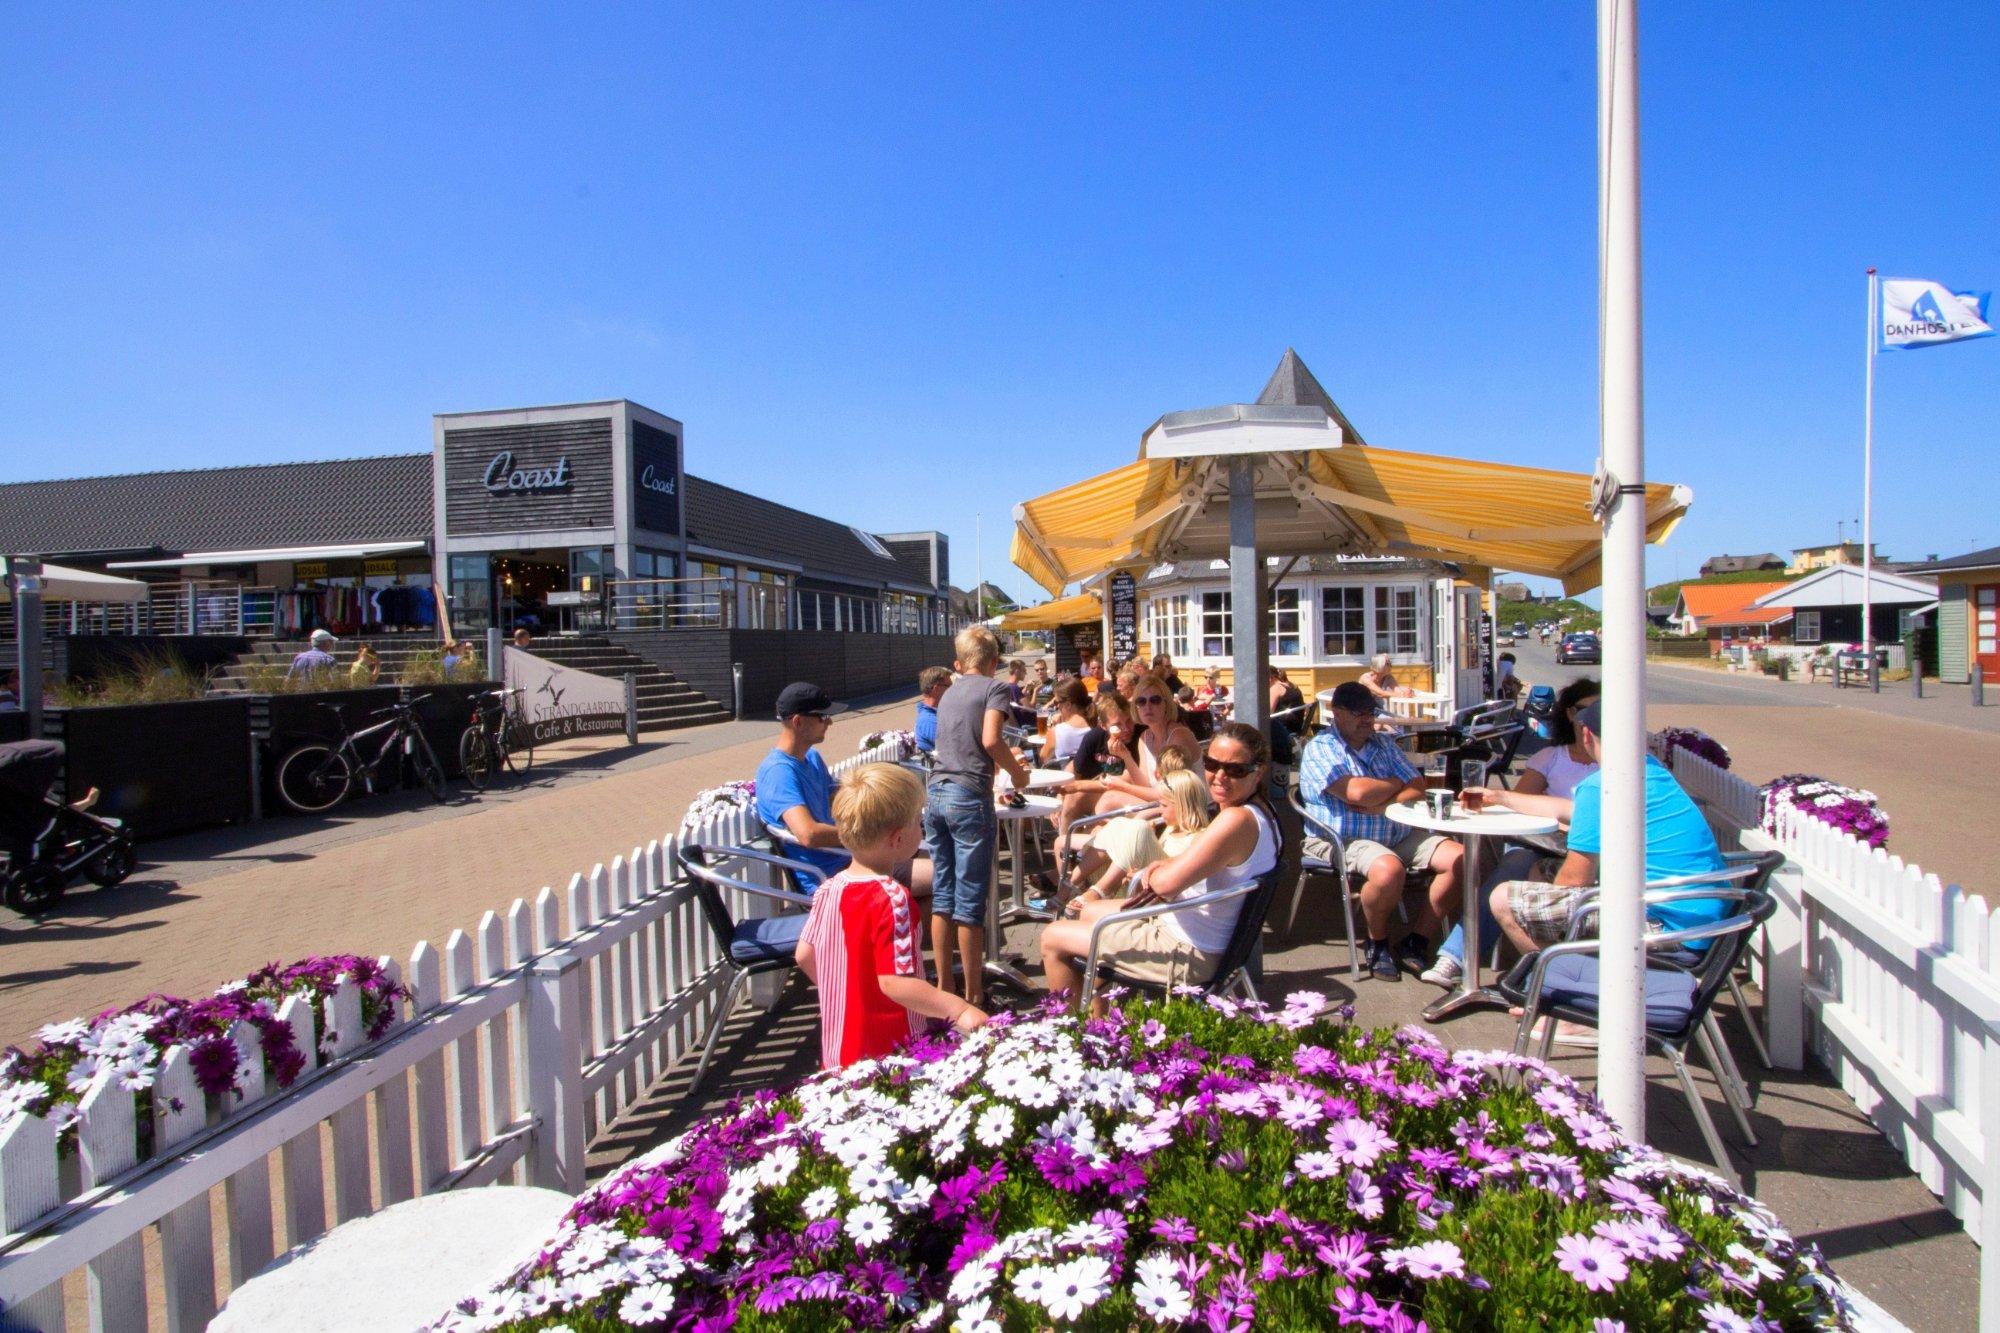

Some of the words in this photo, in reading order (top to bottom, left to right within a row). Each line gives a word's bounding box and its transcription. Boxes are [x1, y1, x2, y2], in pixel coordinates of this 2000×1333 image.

[483, 450, 569, 491] Coast
[641, 464, 675, 495] Coast
[534, 701, 622, 722] STRANDGAARDEN
[563, 719, 573, 735] &
[576, 717, 623, 732] Restaurant
